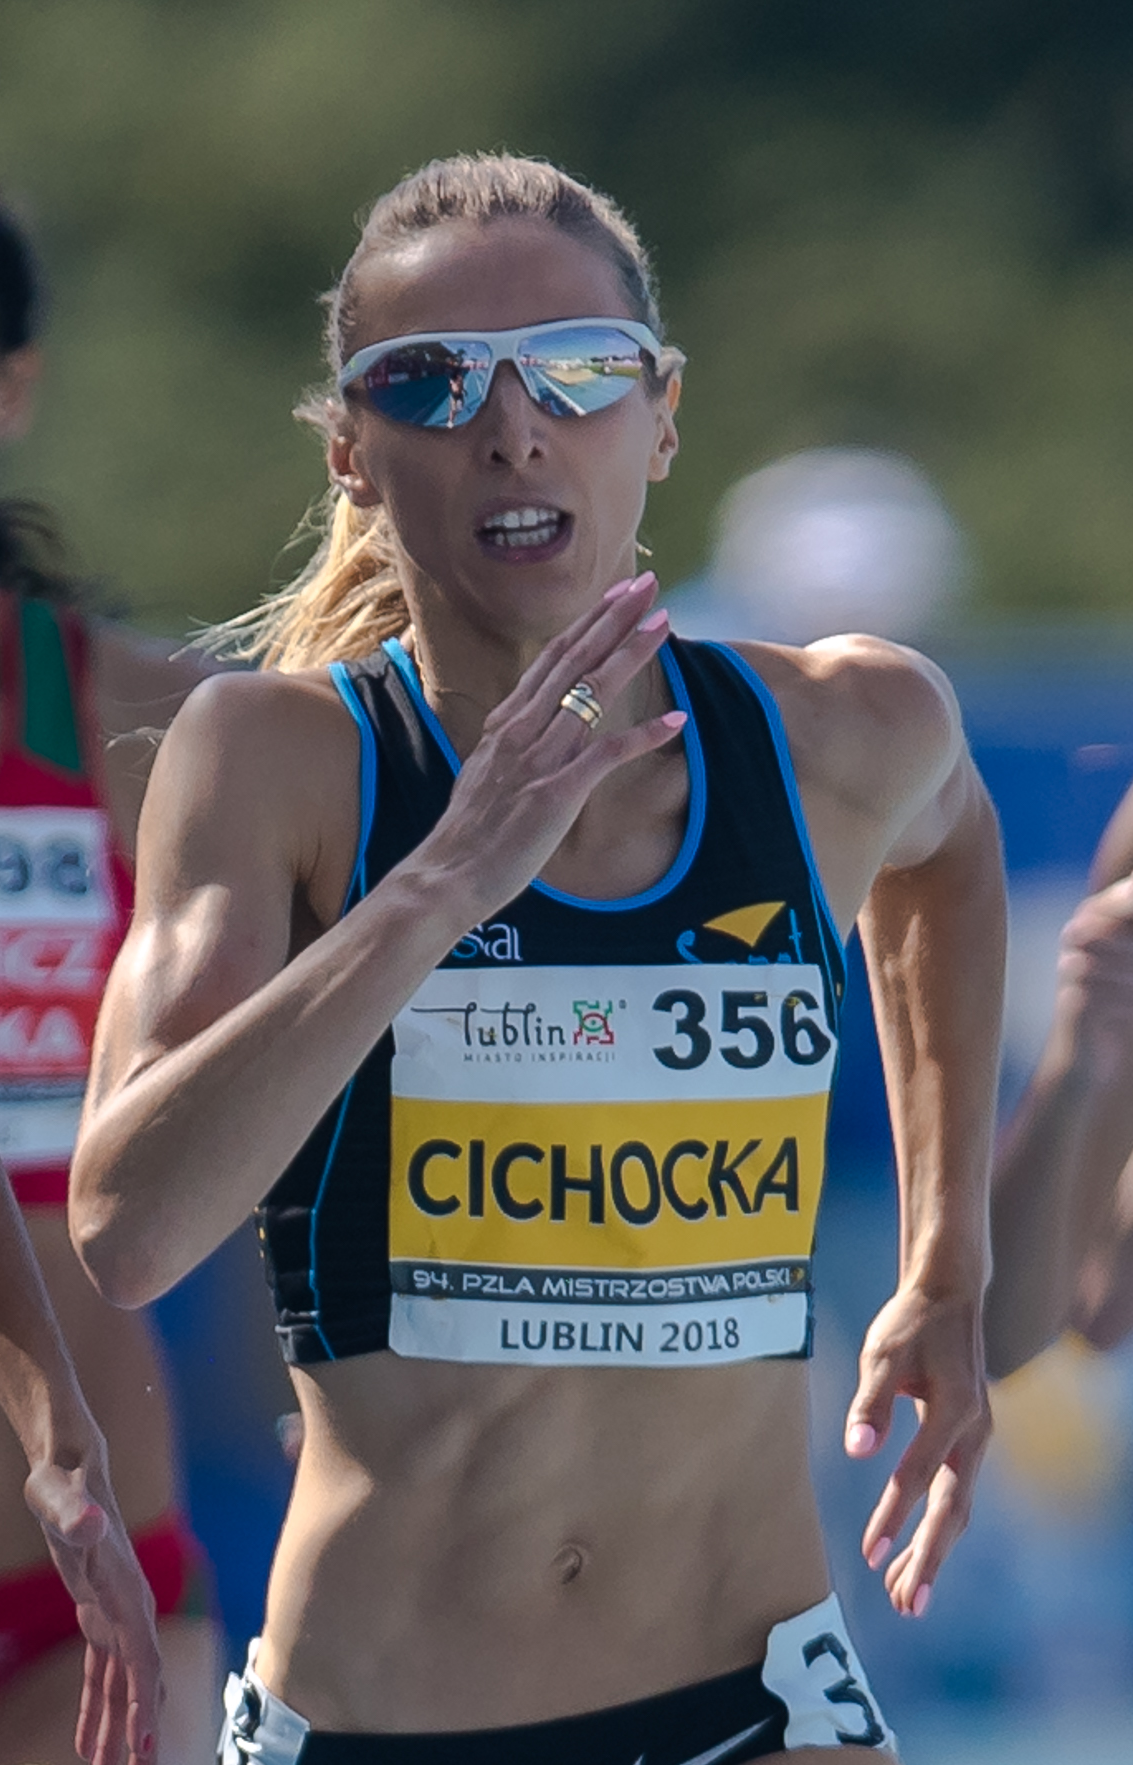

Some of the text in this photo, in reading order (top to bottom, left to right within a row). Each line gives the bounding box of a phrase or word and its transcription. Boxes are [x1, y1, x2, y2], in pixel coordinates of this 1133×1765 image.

[652, 988, 831, 1070] 356
[407, 1136, 799, 1225] CICHOCKA
[412, 1267, 790, 1299] 94. PZLA MISTRZOSTWA POLSKI
[500, 1317, 740, 1353] LUBLIN 2018
[801, 1631, 886, 1746] 3
